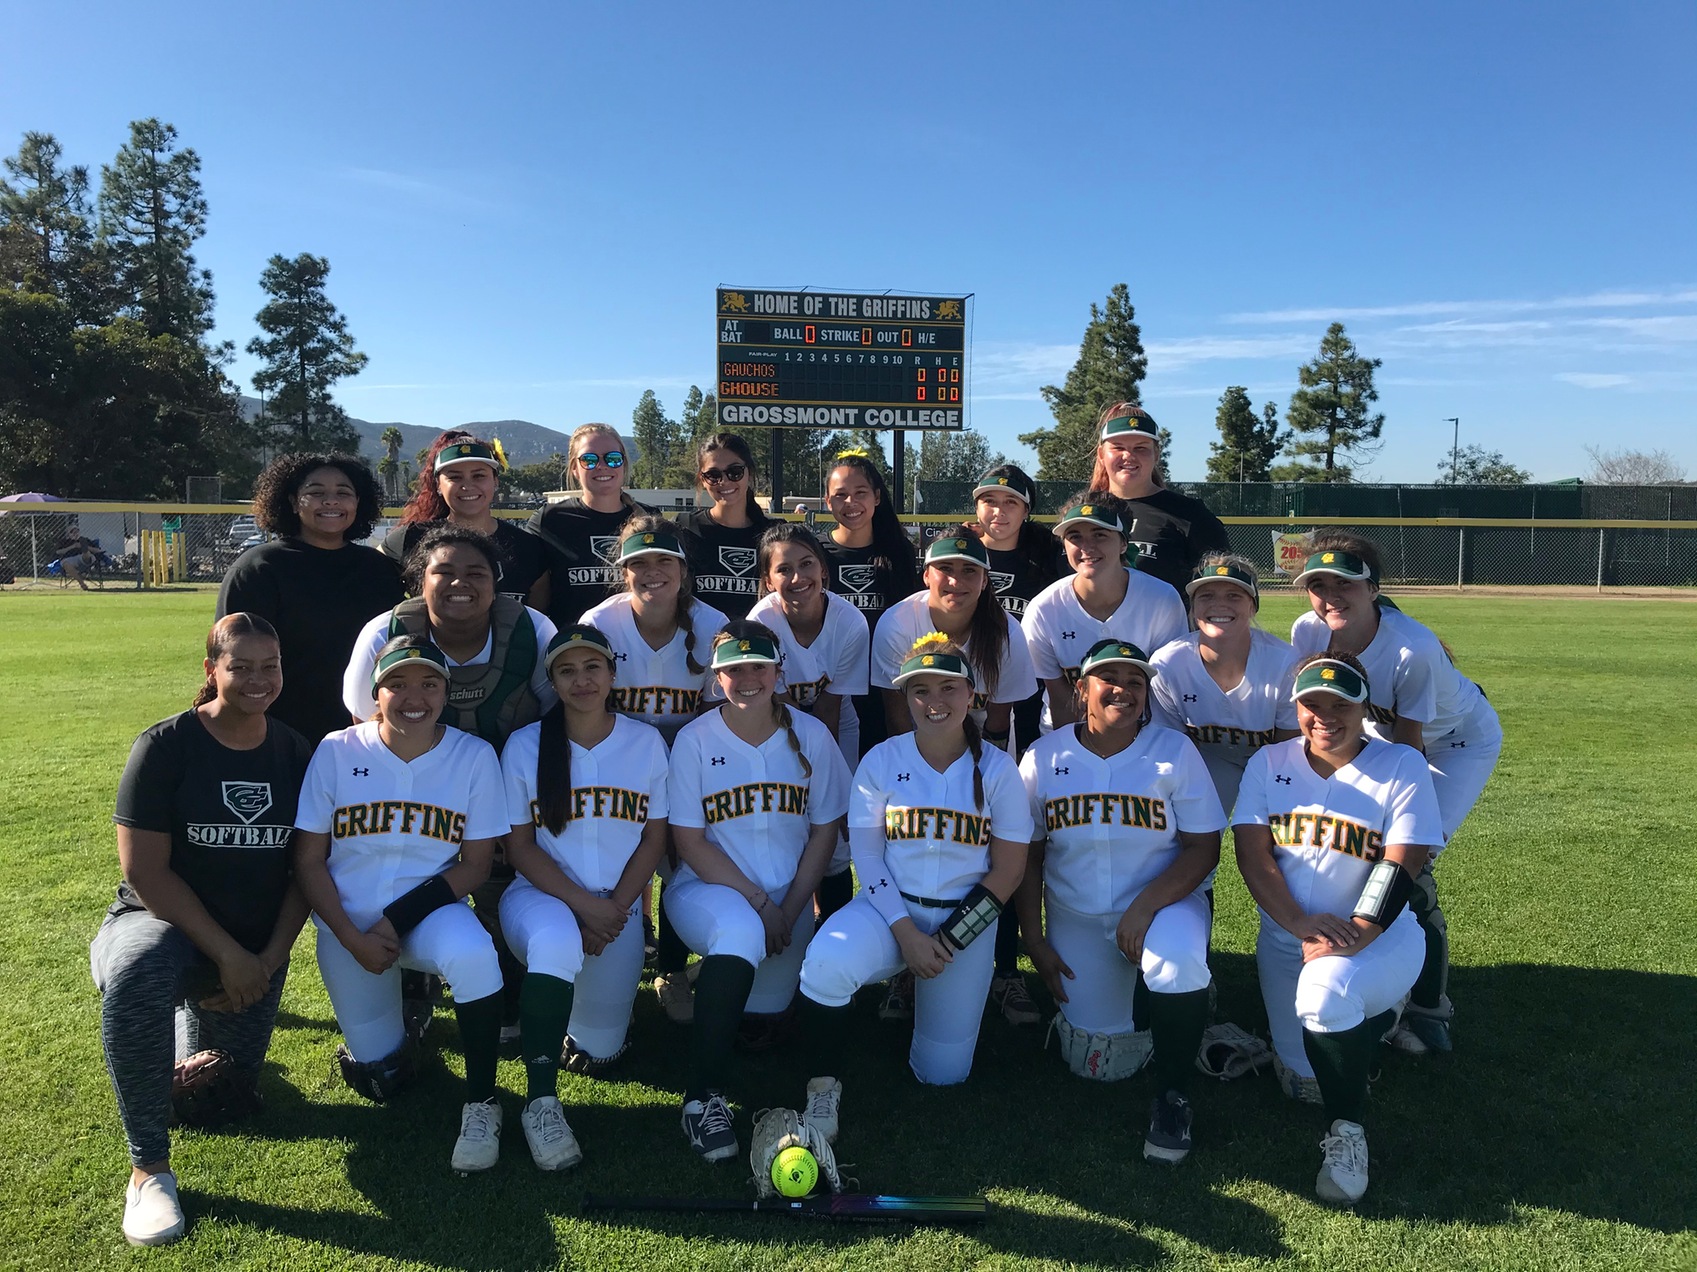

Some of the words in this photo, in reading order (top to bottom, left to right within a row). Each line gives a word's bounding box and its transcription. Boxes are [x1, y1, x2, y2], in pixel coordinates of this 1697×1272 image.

[754, 294, 798, 314] HOME
[804, 296, 823, 315] OF
[829, 297, 857, 316] THE
[862, 298, 930, 319] GRIFFINS
[725, 320, 739, 331] AT
[774, 328, 803, 340] BALL
[805, 325, 815, 343] 0
[821, 329, 860, 341] STRIKE
[862, 327, 872, 345] 0
[877, 332, 899, 343] OUT
[902, 329, 911, 346] 0
[918, 332, 936, 344] H/E
[721, 332, 742, 343] BAT
[785, 352, 790, 361] 1
[797, 353, 803, 361] 2
[809, 353, 815, 362] 3
[821, 353, 828, 362] 4
[834, 354, 840, 363] 5
[846, 354, 852, 363] 6
[859, 355, 865, 363] 7
[870, 355, 876, 364] 8
[883, 355, 889, 364] 9
[892, 356, 903, 364] 10
[915, 356, 921, 365] R
[935, 357, 941, 365] H
[953, 357, 958, 366] E
[724, 362, 775, 377] GAUCHOS
[917, 368, 926, 382] 0
[938, 368, 946, 382] 0
[950, 368, 959, 382] 0
[720, 382, 779, 396] GHOUSE
[917, 386, 926, 400] 0
[938, 386, 946, 400] 0
[950, 387, 959, 401] 0
[722, 405, 858, 425] GROSSMONT
[864, 409, 959, 427] COLLEGE
[450, 688, 485, 700] schutt
[1045, 793, 1168, 832] GRIFFINS
[332, 801, 468, 845] GRIFFINS
